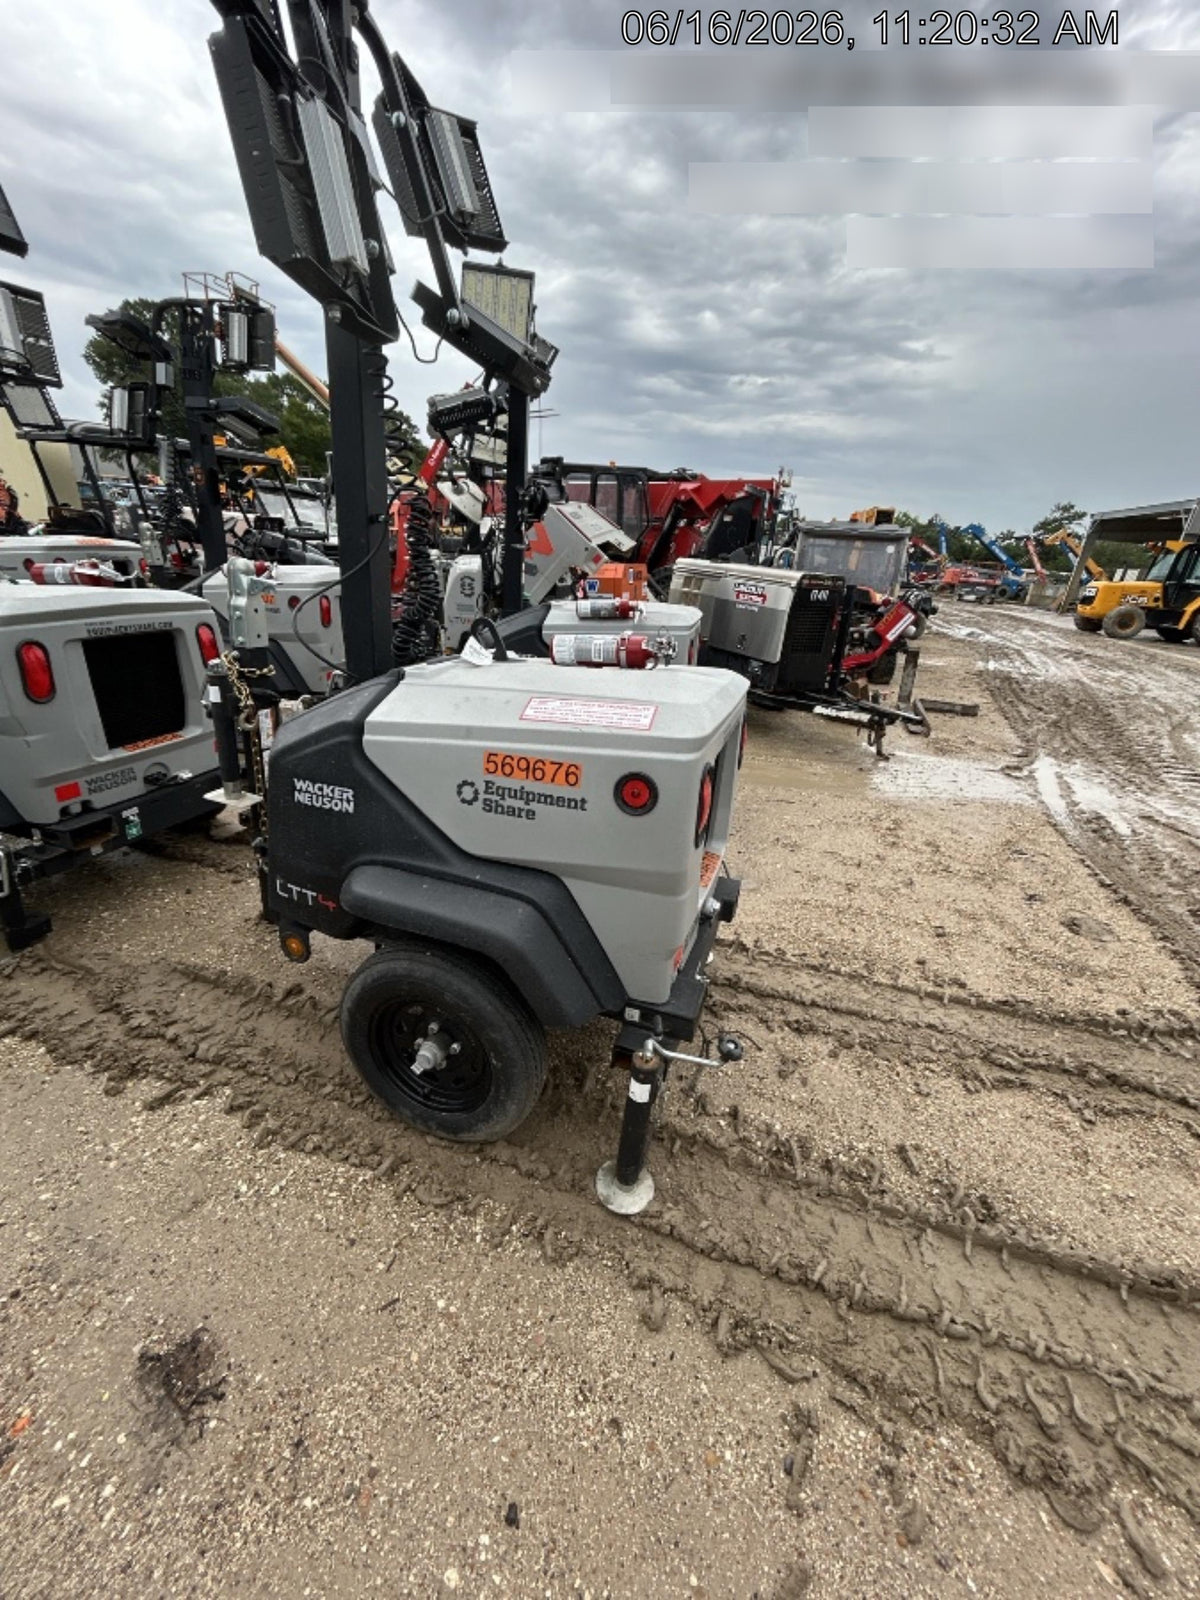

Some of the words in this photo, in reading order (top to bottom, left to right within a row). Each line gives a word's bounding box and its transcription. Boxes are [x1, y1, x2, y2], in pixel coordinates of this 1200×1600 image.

[84, 767, 136, 787] WACKER
[485, 753, 579, 787] 569676
[87, 775, 138, 796] NEUSON
[293, 778, 354, 801] WACKER
[483, 780, 588, 811] Equipment
[294, 791, 354, 814] NEUSON
[482, 798, 536, 820] Share
[276, 879, 337, 912] LTT4
